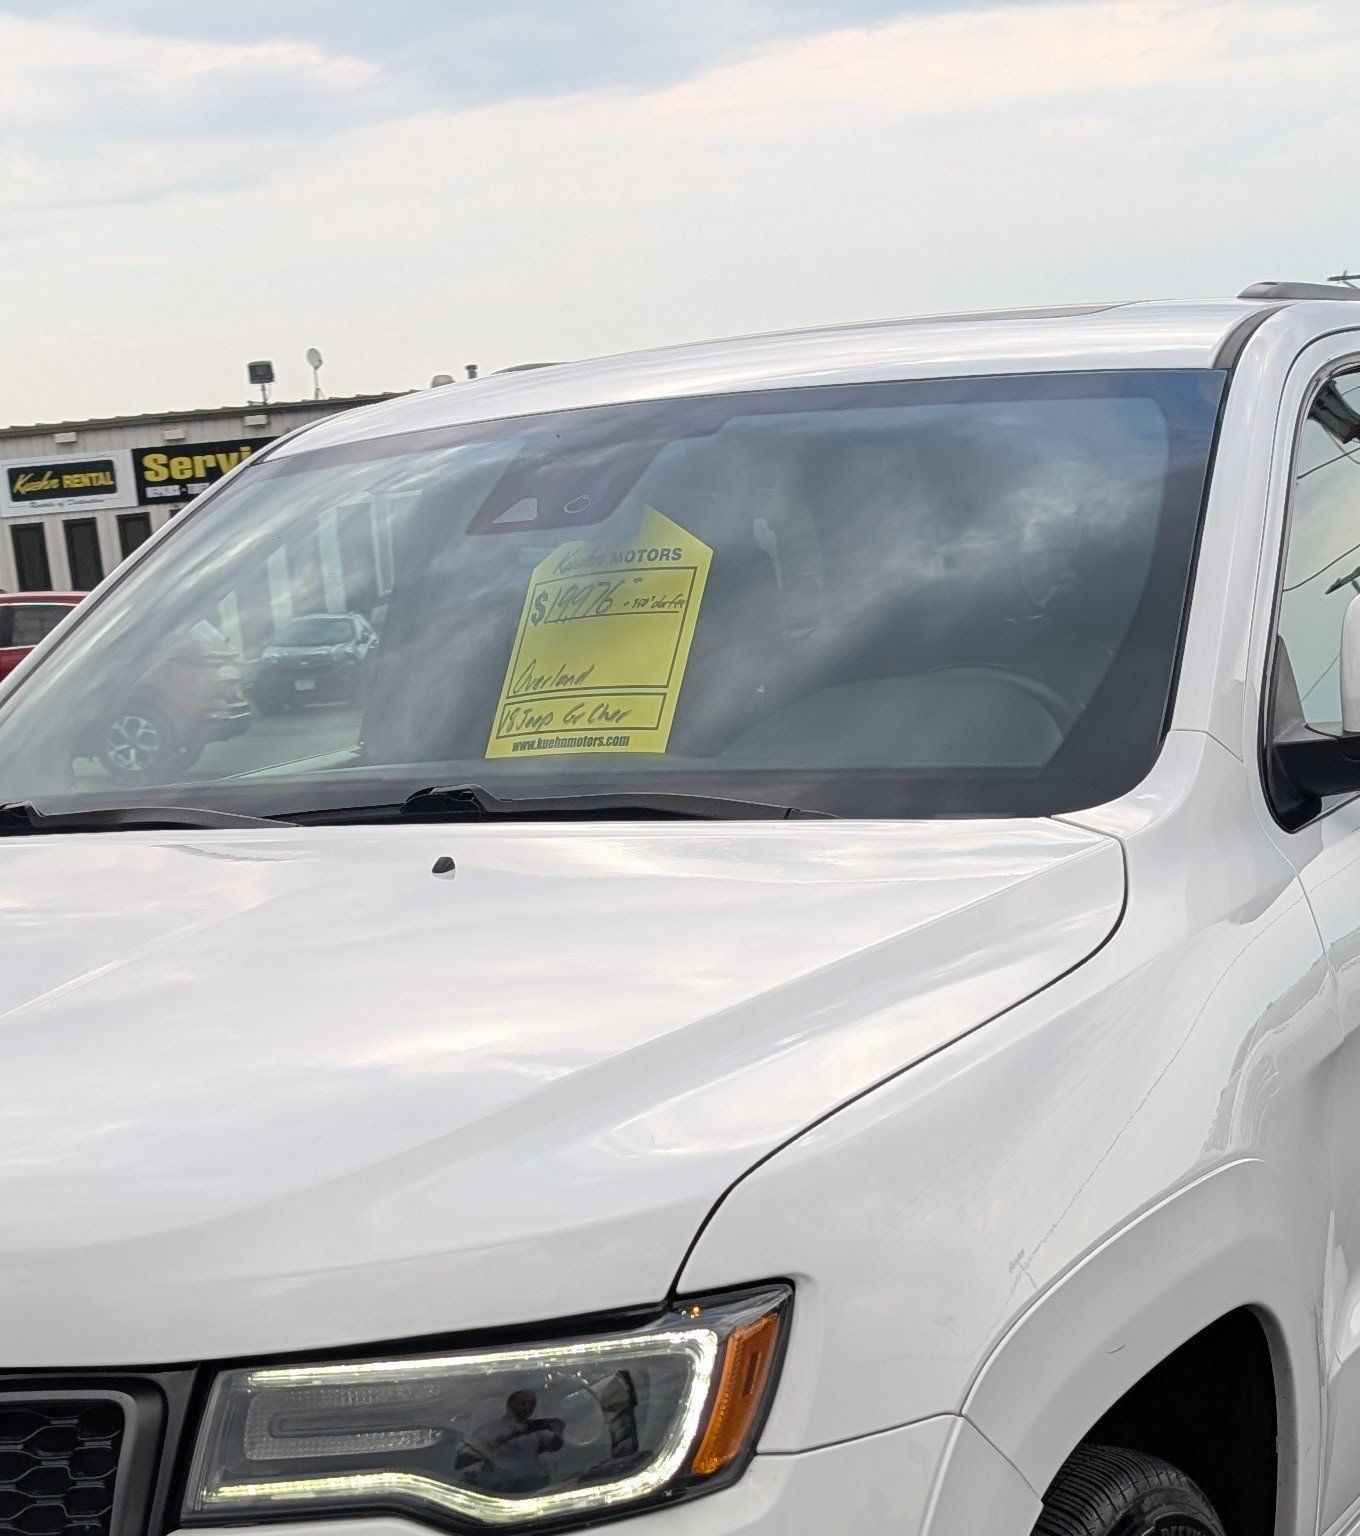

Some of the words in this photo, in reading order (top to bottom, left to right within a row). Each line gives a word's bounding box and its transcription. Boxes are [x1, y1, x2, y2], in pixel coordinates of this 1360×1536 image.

[62, 471, 115, 488] RENTAL
[611, 547, 683, 564] MOTORS
[513, 658, 595, 694] Overland
[516, 707, 554, 732] Jeep
